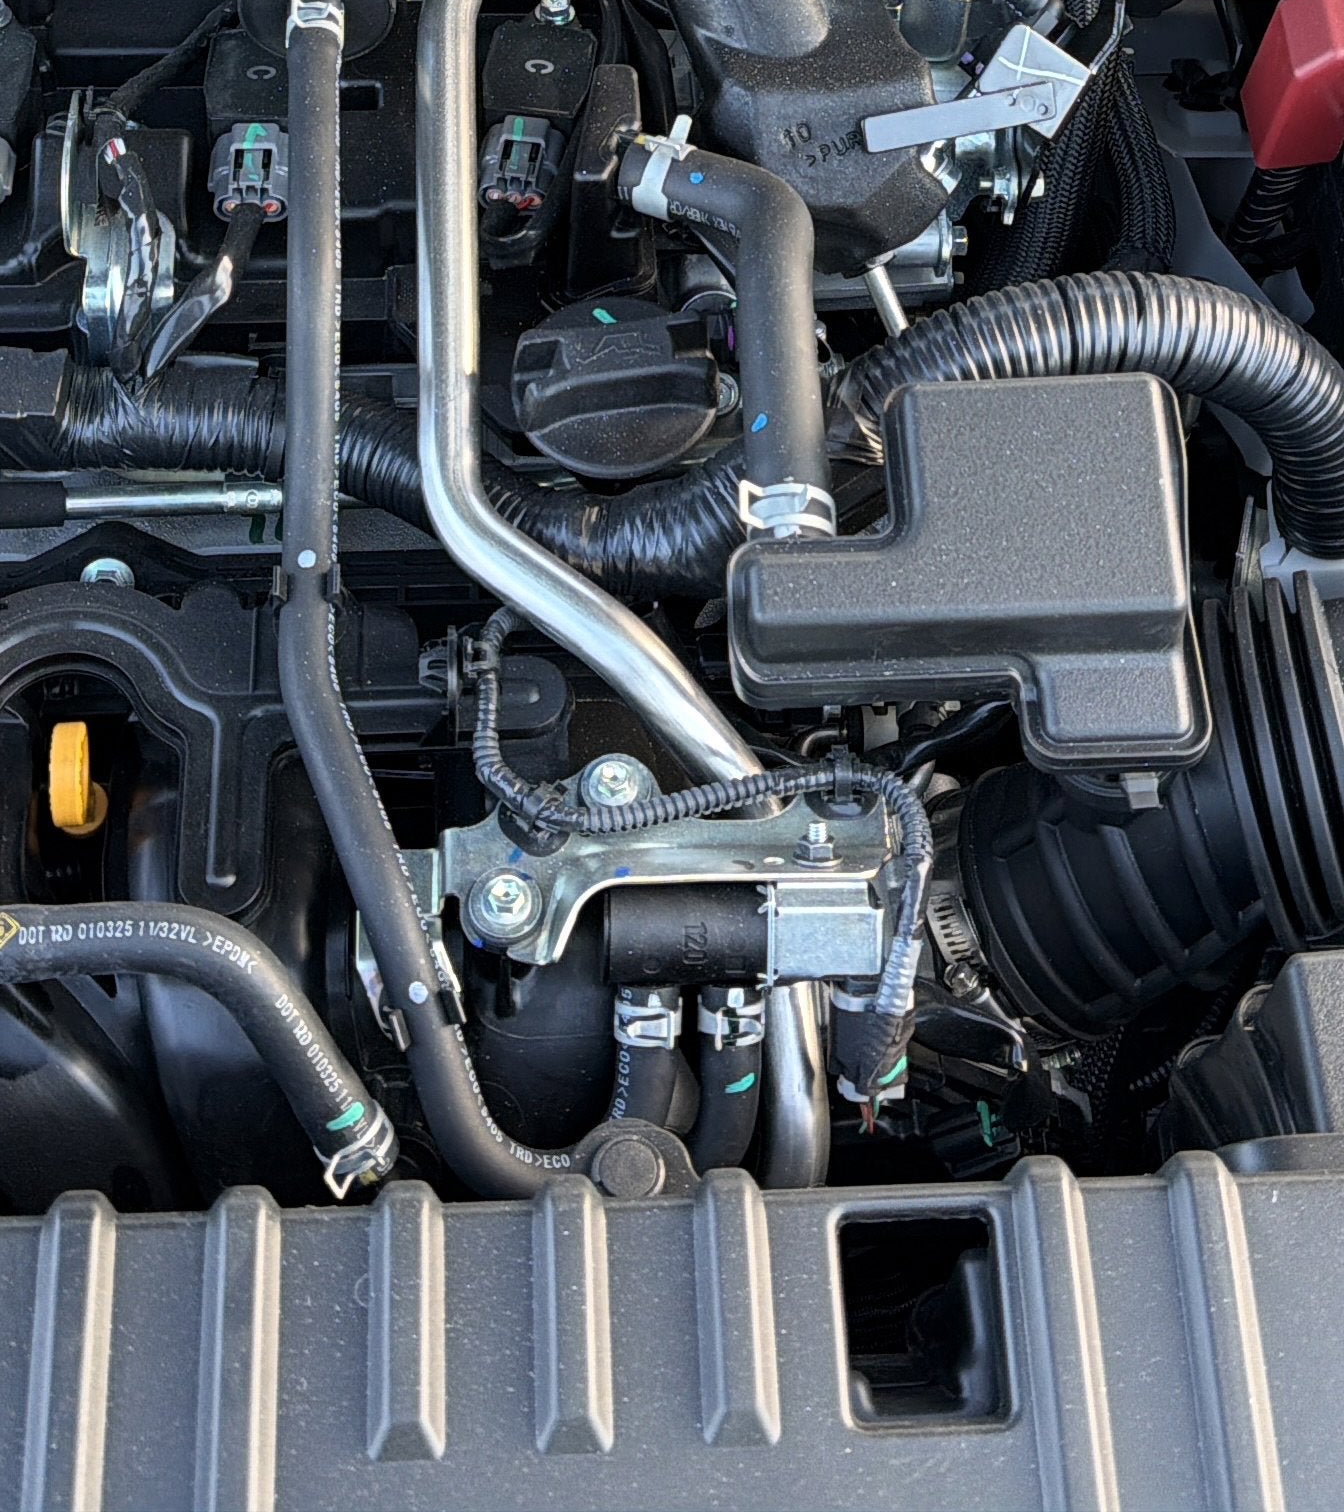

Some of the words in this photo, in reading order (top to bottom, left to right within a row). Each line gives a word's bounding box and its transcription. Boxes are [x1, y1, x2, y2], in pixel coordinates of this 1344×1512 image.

[246, 65, 277, 80] C
[524, 59, 555, 75] C
[18, 926, 44, 945] DOT
[78, 920, 133, 940] 010325
[275, 993, 300, 1025] DOT
[306, 1043, 344, 1093] 010325
